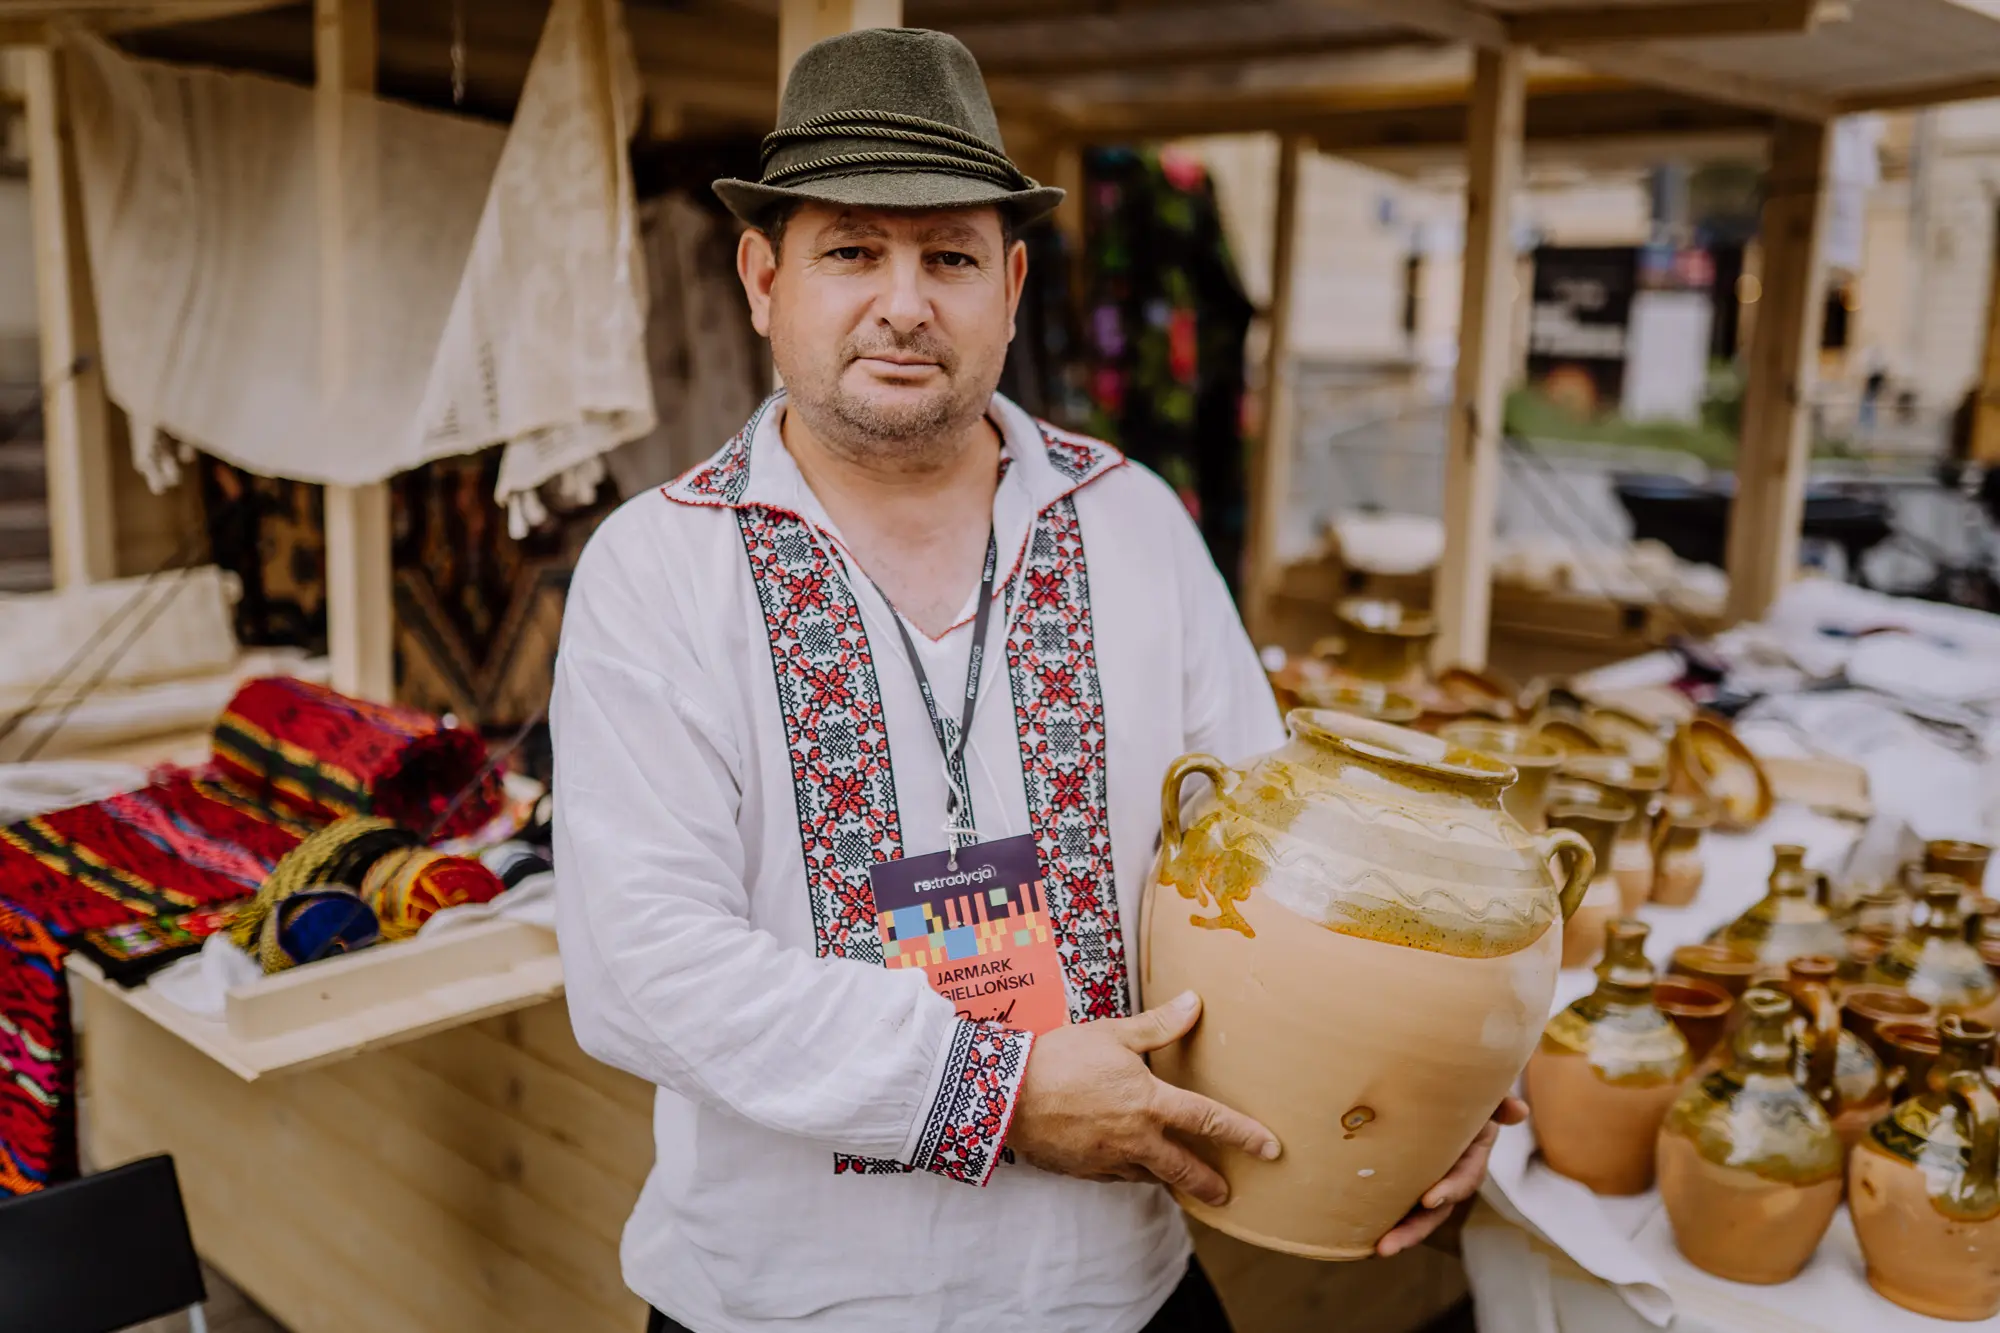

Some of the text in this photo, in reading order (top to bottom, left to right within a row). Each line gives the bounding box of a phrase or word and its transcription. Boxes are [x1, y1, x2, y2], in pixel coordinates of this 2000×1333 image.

[966, 645, 982, 700] re:tradycja
[914, 866, 993, 893] re:tradycja
[937, 958, 1013, 986] JARMARK
[940, 973, 1034, 1001] GIELLOŃSKI
